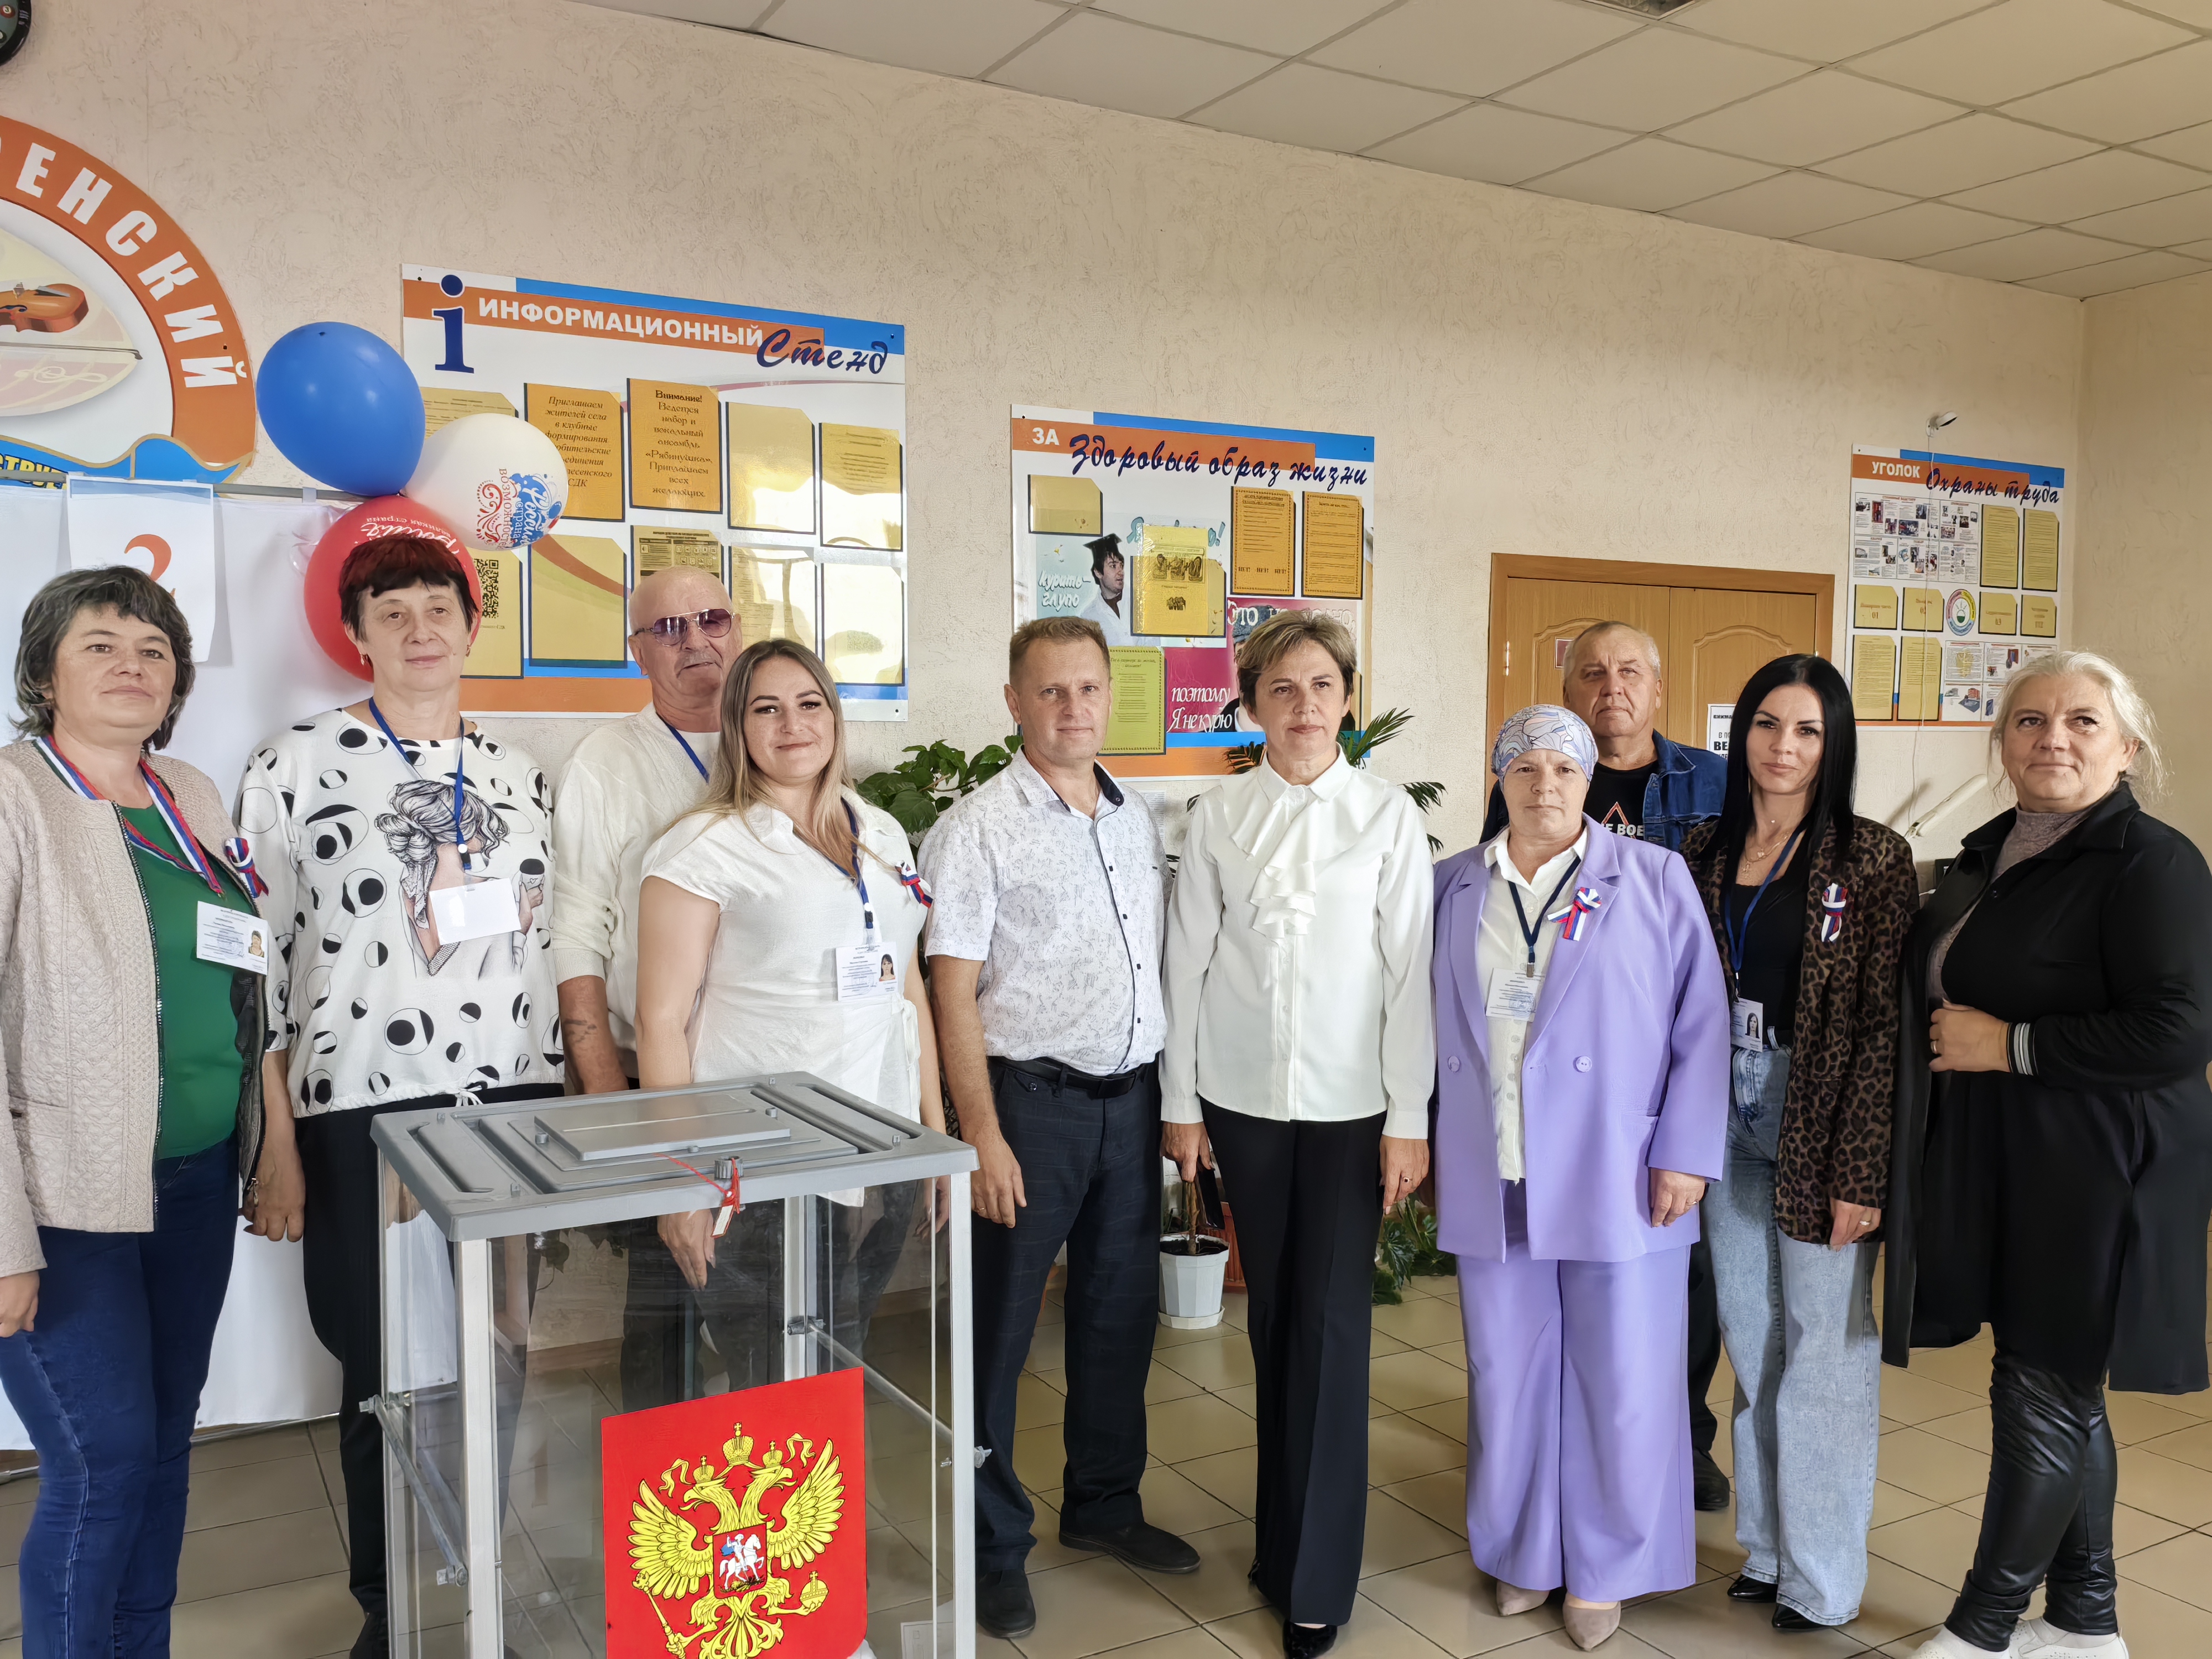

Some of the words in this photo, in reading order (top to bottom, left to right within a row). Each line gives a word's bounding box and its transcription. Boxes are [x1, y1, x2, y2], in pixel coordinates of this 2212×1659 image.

[0, 141, 247, 388] ЕНСКИЙ
[479, 297, 764, 347] ИНФОРМАЦИОННЫЙ
[757, 328, 888, 374] Стенд
[548, 396, 603, 409] Приглашаем
[655, 390, 702, 403] Внимание!
[545, 409, 586, 418] жителей
[562, 422, 598, 431] клубные
[662, 415, 687, 426] набор
[654, 427, 703, 437] вокальный
[563, 456, 604, 466] единения
[1032, 427, 1060, 446] ЗА
[1070, 434, 1199, 477] Здоровый
[1209, 447, 1280, 487] образ
[1289, 462, 1367, 491] жизни
[649, 461, 708, 474] Приглашаем
[568, 478, 588, 487] СДК
[1872, 461, 1921, 478] УГОЛОК
[1926, 468, 1998, 498] Охраны
[2004, 481, 2060, 507] труда
[1171, 687, 1230, 706] поэтому
[1166, 707, 1186, 733] Я
[1183, 714, 1197, 729] не
[1199, 714, 1233, 733] курю
